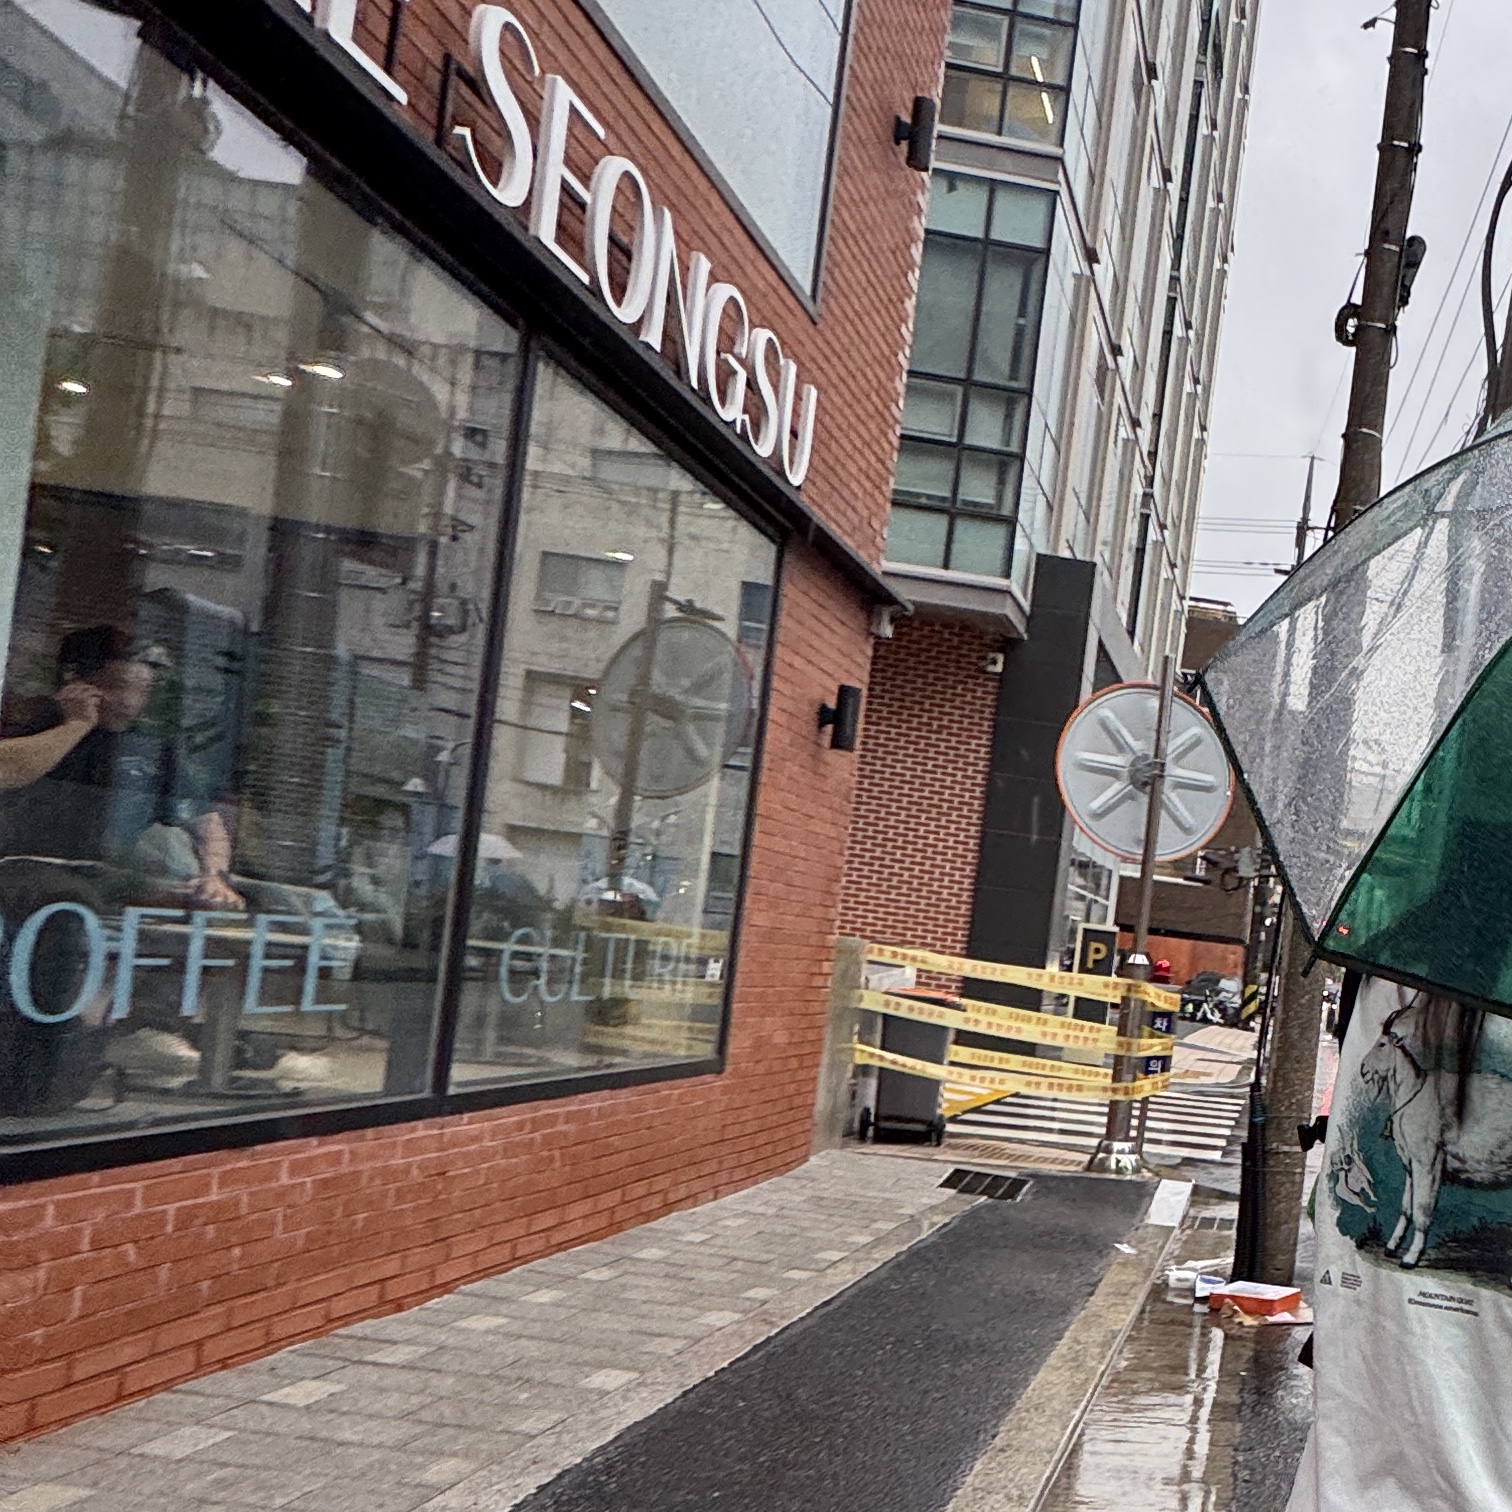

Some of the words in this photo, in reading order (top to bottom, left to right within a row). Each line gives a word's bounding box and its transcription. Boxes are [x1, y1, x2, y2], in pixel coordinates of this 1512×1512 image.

[452, 4, 817, 487] SEONGSU
[0, 902, 359, 1024] OFFEE
[1086, 941, 1108, 970] P
